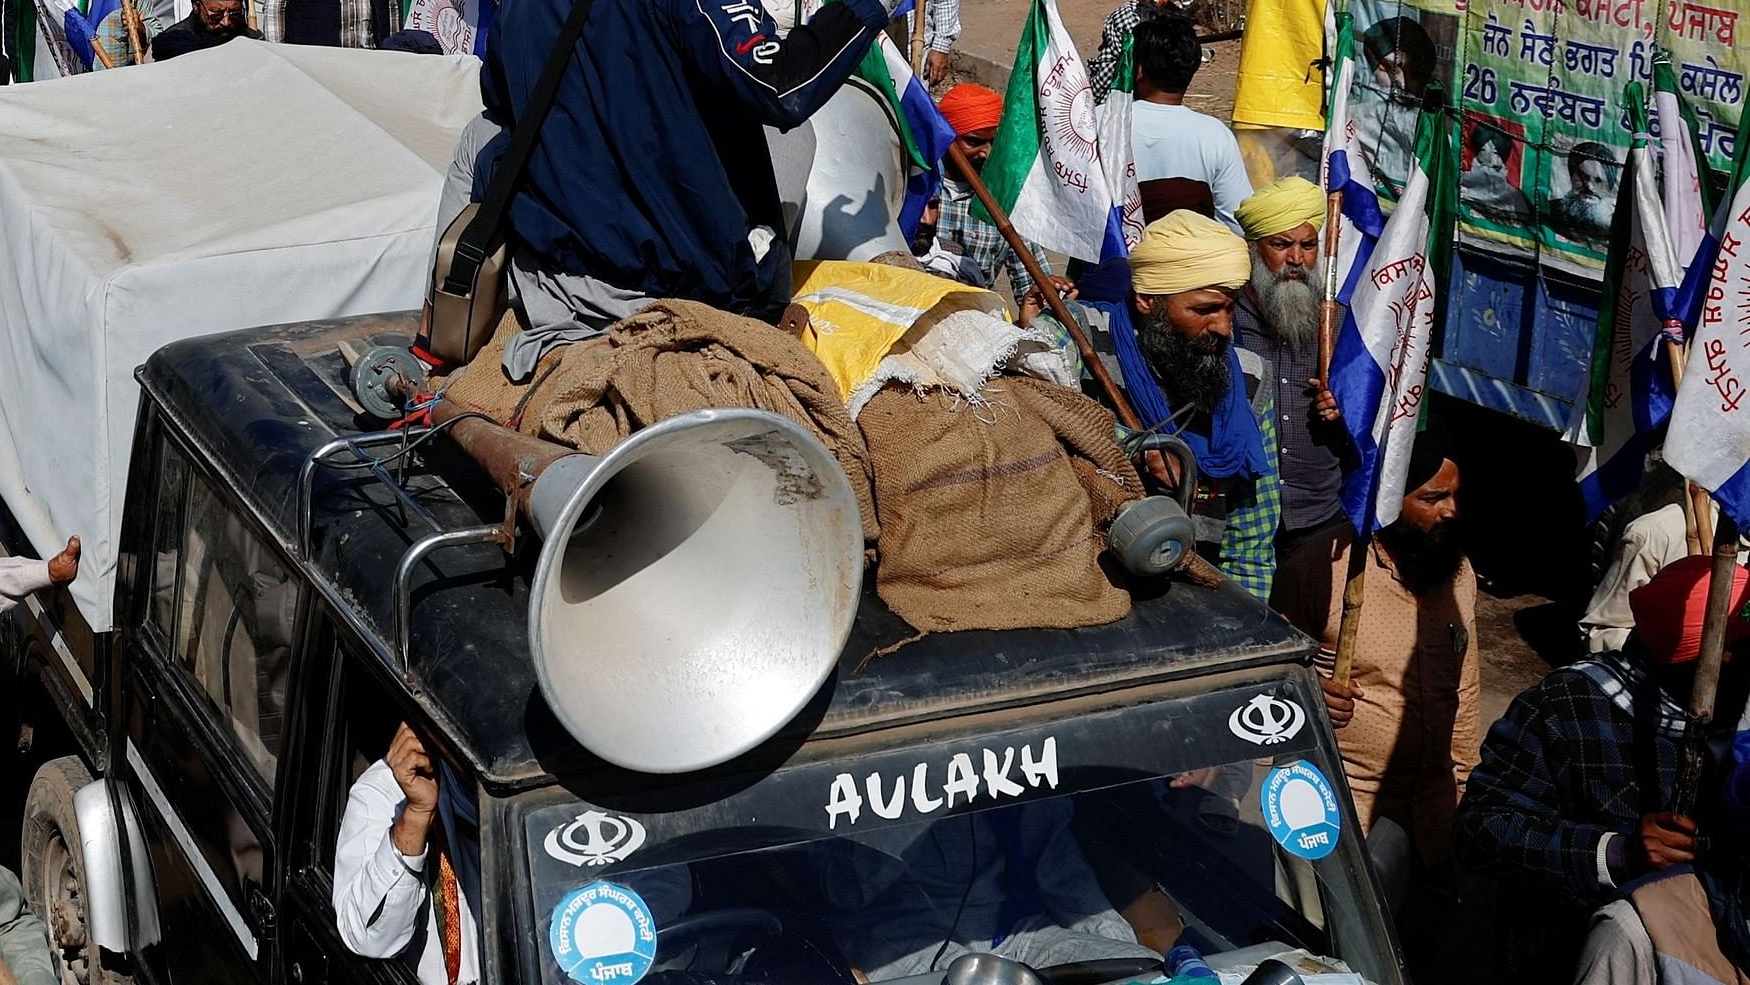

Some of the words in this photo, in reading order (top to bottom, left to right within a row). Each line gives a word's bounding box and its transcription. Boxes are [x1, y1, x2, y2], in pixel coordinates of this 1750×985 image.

[1565, 40, 1619, 78] ਭਗਤ
[1464, 63, 1496, 105] 26
[1510, 75, 1606, 129] ਨਵੰਬਰ
[825, 736, 1059, 830] AULAKH
[1298, 832, 1329, 850] ਪੰਜਾਬ
[590, 961, 633, 982] ਪੰਜਾਬ
